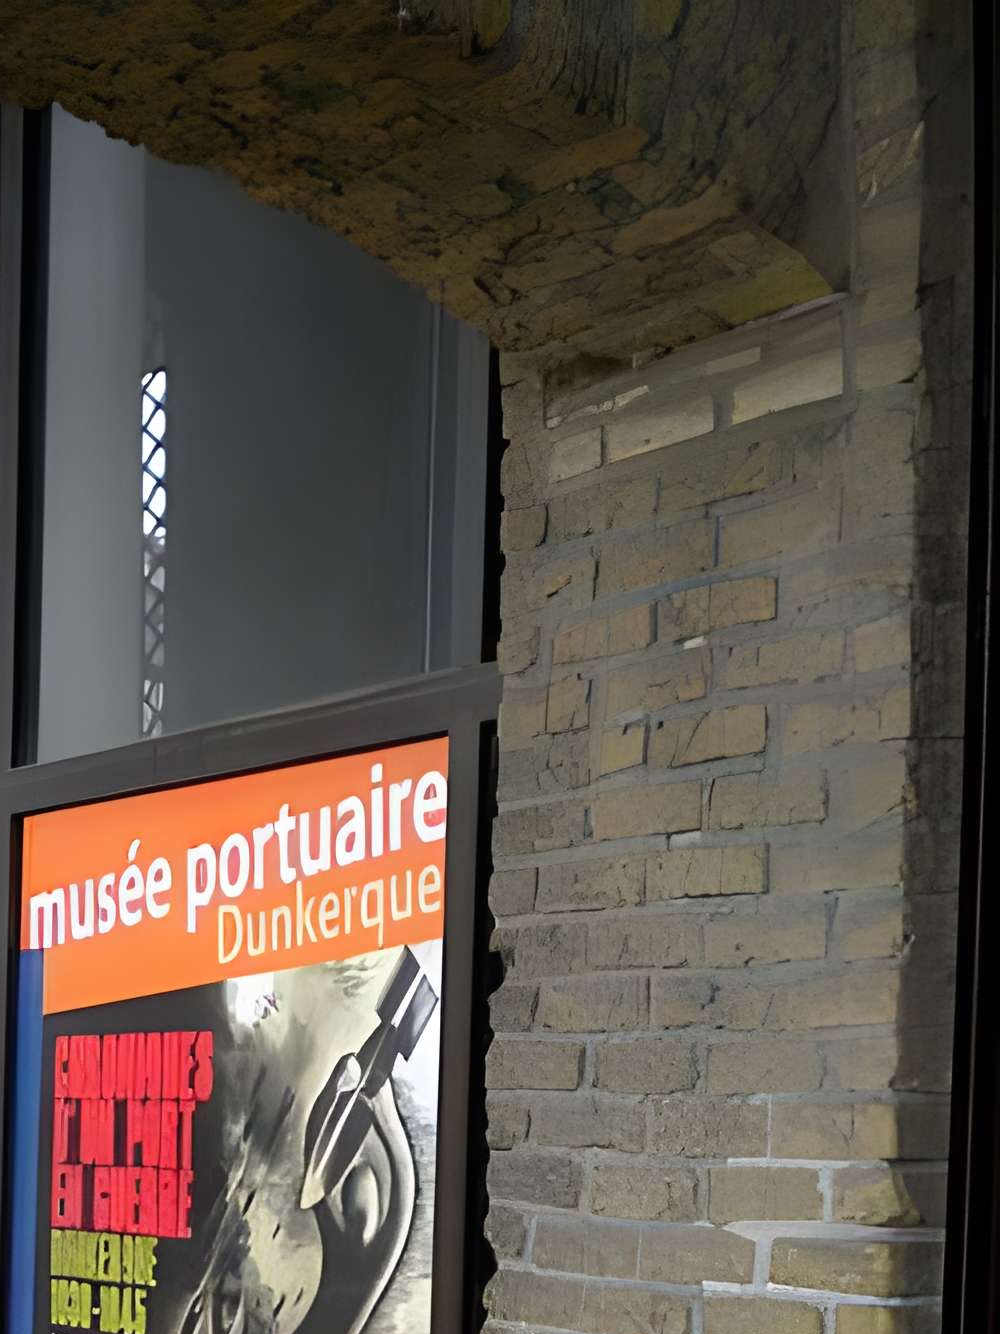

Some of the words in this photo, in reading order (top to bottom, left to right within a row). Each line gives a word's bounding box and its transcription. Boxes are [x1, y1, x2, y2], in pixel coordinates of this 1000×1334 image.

[29, 838, 173, 950] musée
[186, 763, 448, 934] portuaire
[217, 864, 441, 965] Dunkerque
